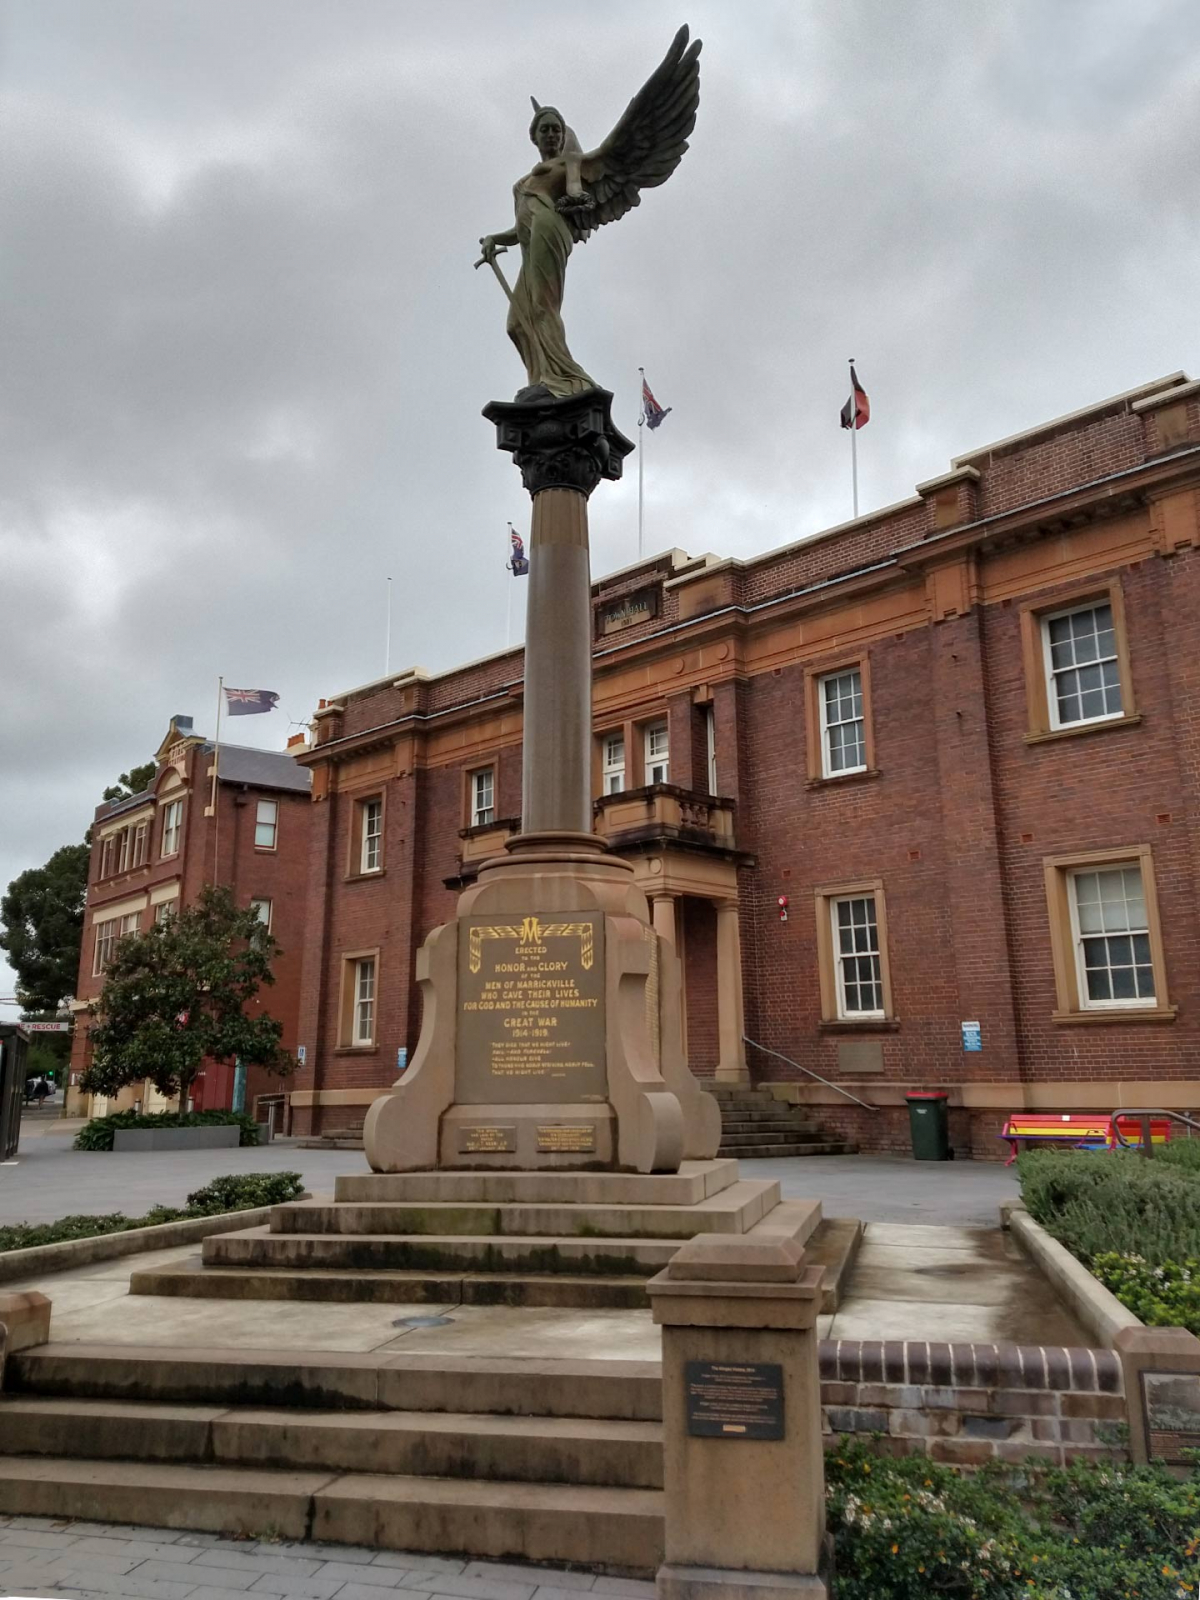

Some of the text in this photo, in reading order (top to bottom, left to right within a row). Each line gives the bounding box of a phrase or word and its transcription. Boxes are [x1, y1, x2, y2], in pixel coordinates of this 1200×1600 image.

[515, 946, 547, 954] ERECTED
[495, 963, 525, 972] HONOR
[538, 961, 568, 971] GLORY
[485, 979, 575, 990] MEN OF MARRICKVILLE
[481, 988, 579, 1000] WHO GAVE THEIR LIVES
[464, 999, 598, 1010] FOR GOD AND THE CAUSE OF HUMANITY
[504, 1017, 557, 1027] GREAT WAR
